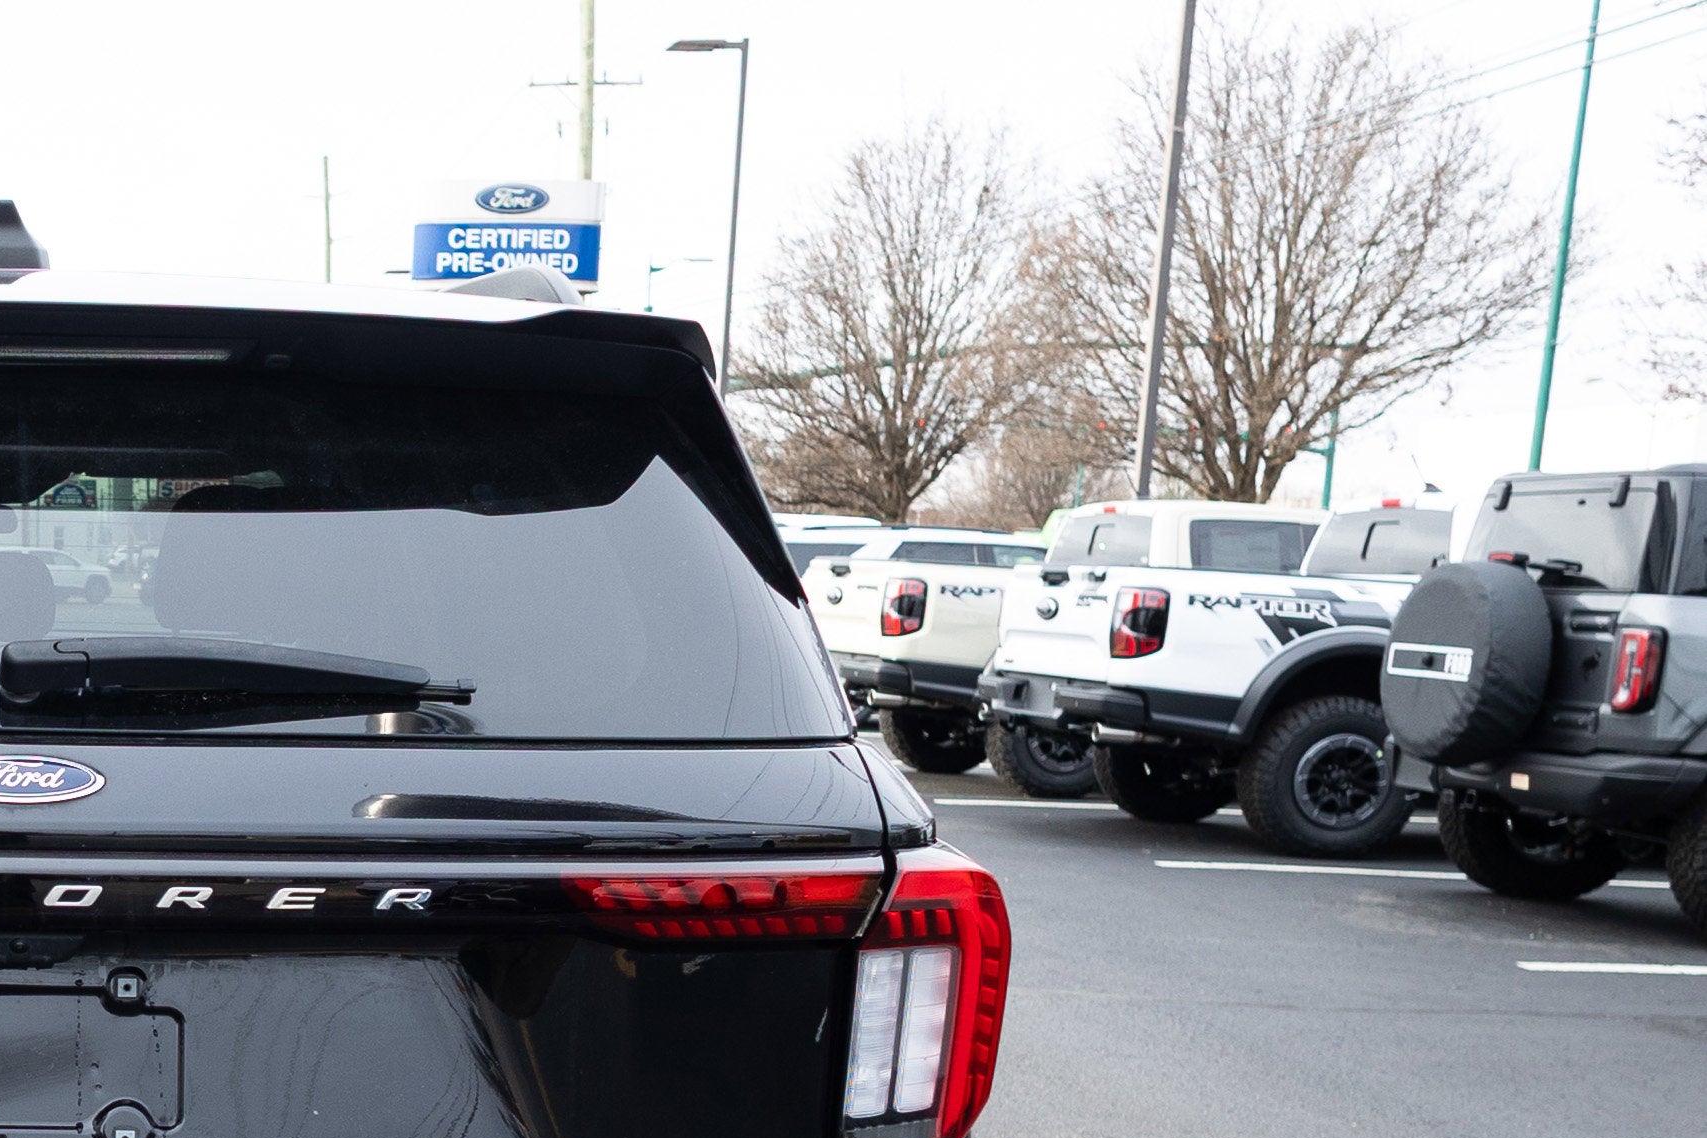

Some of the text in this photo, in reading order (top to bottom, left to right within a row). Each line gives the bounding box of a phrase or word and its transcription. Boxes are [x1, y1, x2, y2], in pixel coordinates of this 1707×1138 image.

[490, 186, 536, 209] Ford
[447, 227, 571, 250] CERTIFIED
[1188, 593, 1338, 627] RAPTOR
